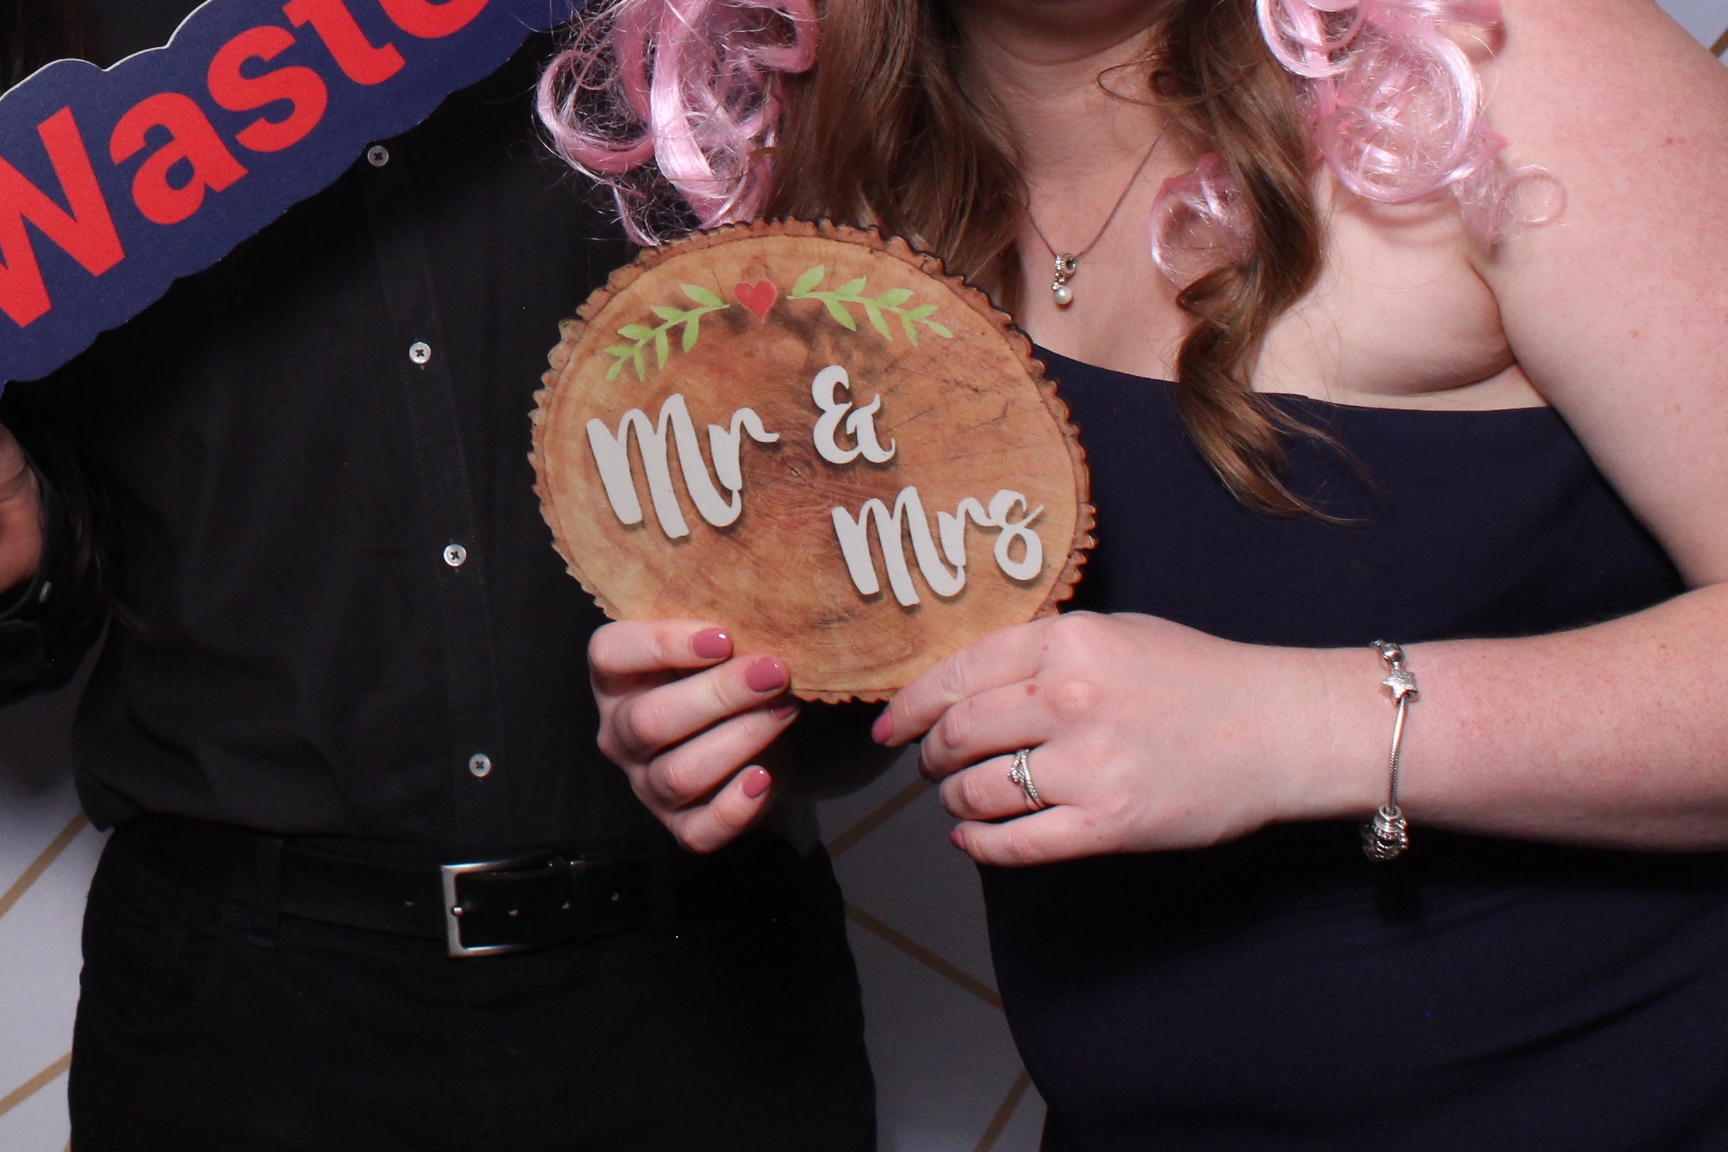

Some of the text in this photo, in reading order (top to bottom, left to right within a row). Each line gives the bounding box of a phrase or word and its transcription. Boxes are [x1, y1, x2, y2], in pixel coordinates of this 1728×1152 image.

[586, 364, 896, 539] Mr &
[831, 485, 1044, 607] Mrs
